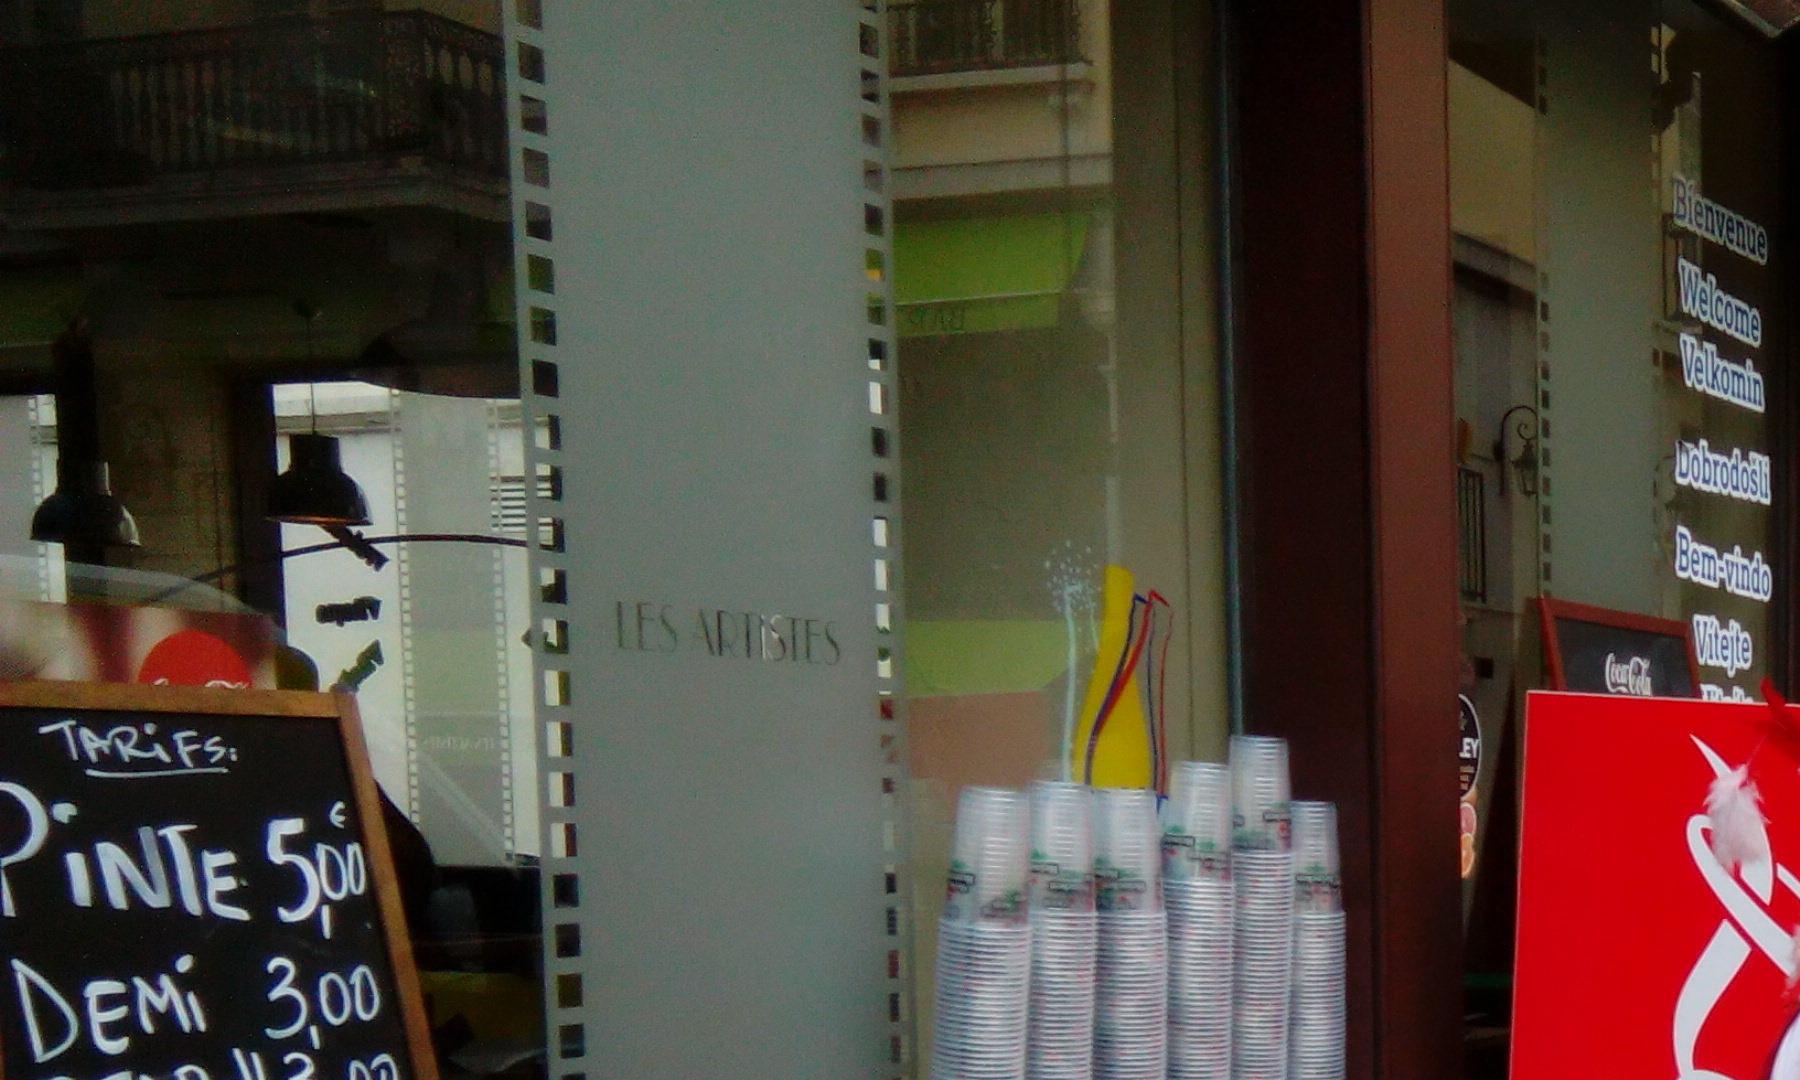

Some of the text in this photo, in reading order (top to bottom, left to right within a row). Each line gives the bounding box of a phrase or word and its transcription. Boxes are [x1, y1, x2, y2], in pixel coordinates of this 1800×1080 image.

[1674, 175, 1767, 264] Bienvenue
[1679, 257, 1761, 346] Welcome
[1680, 334, 1765, 413] Velkomin
[1676, 525, 1771, 602] Bem-vindo
[615, 600, 841, 666] LES ARTISTES
[264, 956, 382, 1050] 3,00
